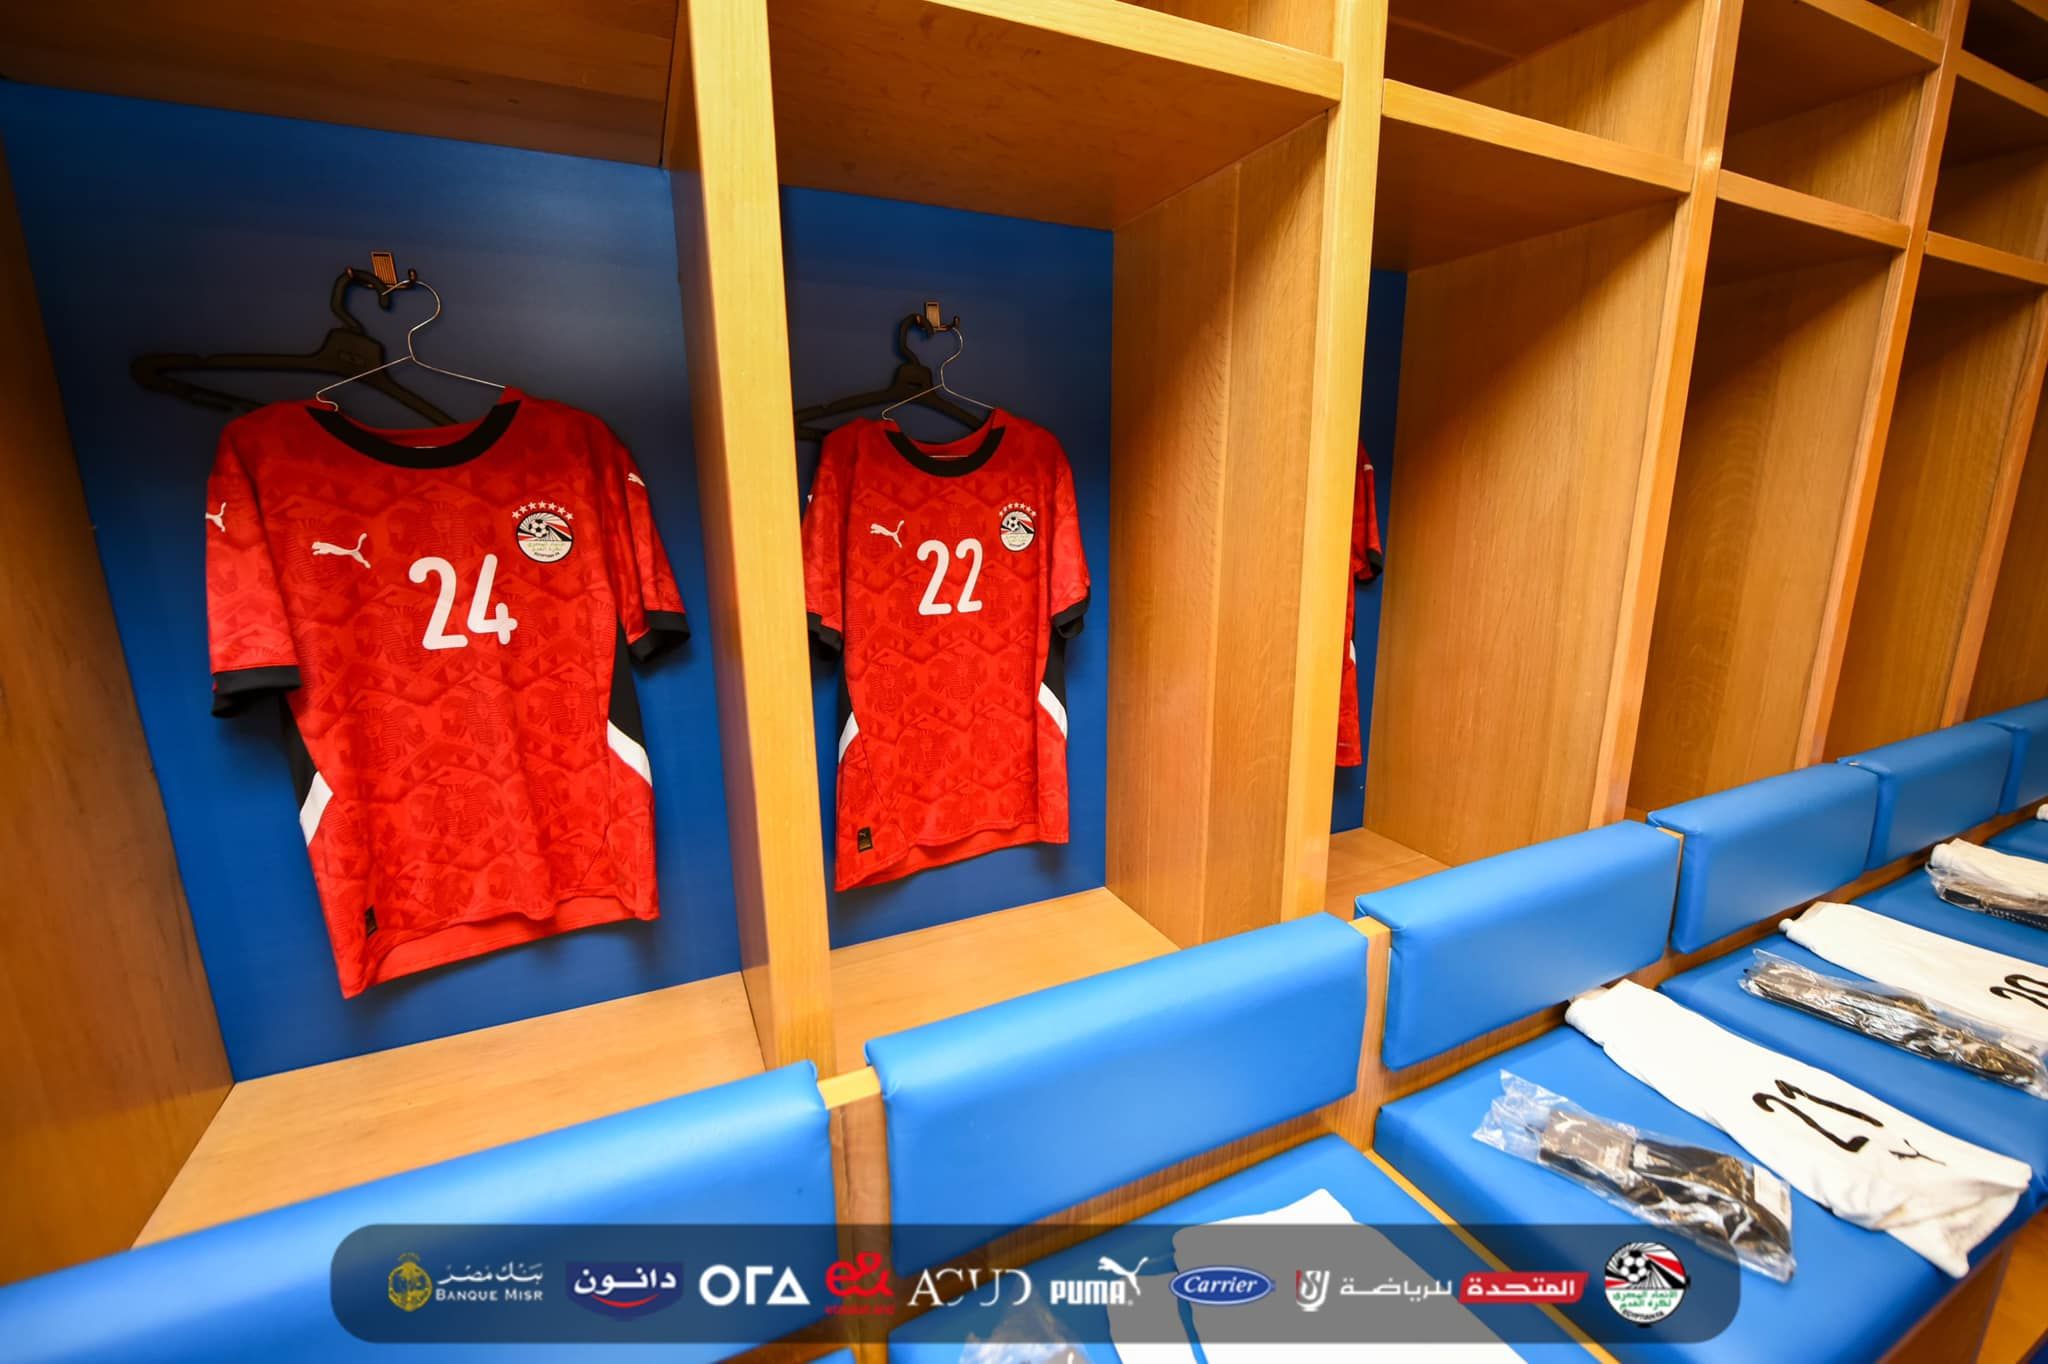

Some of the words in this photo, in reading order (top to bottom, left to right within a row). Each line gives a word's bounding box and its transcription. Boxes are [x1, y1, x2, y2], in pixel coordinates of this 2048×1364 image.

[408, 553, 518, 650] 24
[916, 538, 983, 616] 22
[1752, 1079, 1884, 1153] 21
